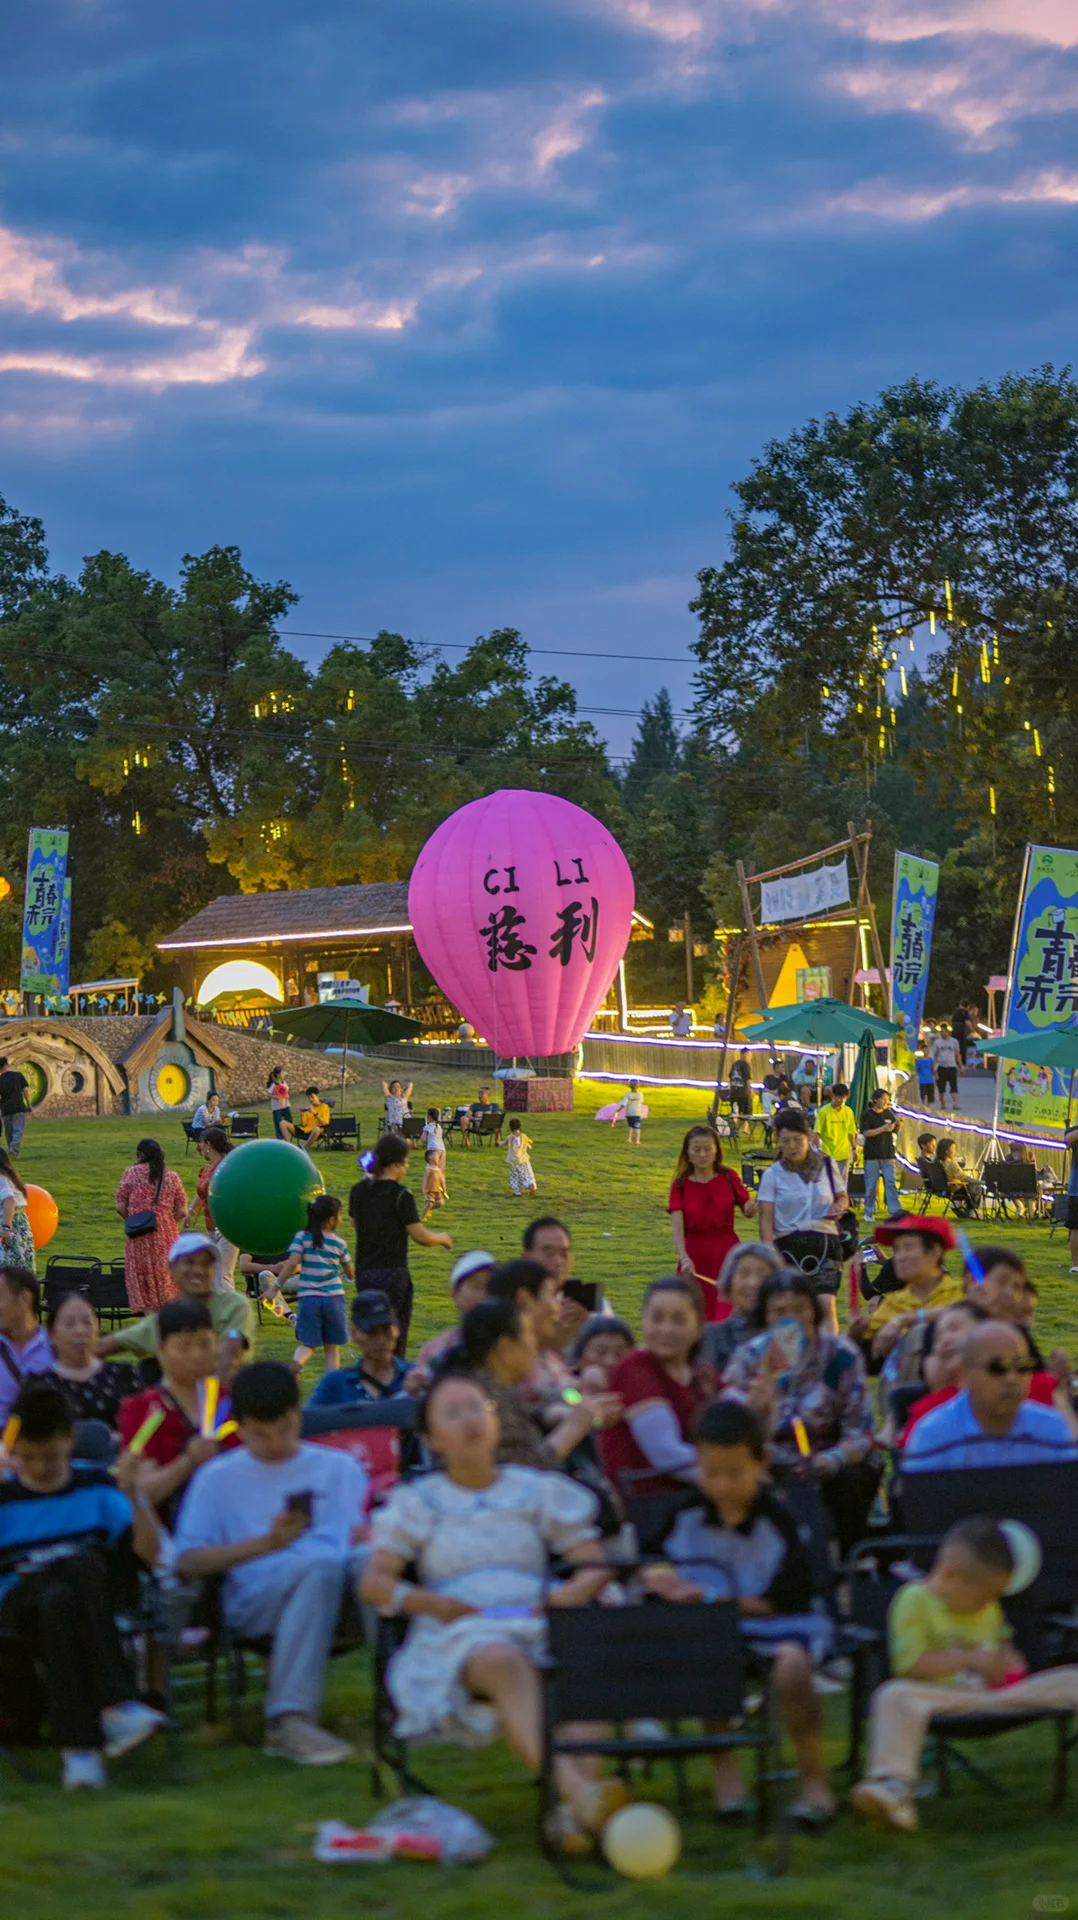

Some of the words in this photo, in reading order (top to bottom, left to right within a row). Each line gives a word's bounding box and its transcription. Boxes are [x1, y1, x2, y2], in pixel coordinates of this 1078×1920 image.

[33, 871, 58, 907] 青春
[484, 866, 520, 895] CI
[554, 858, 589, 886] LI
[26, 905, 56, 926] 未完
[479, 896, 598, 972] 慈利
[901, 913, 924, 960] 青春
